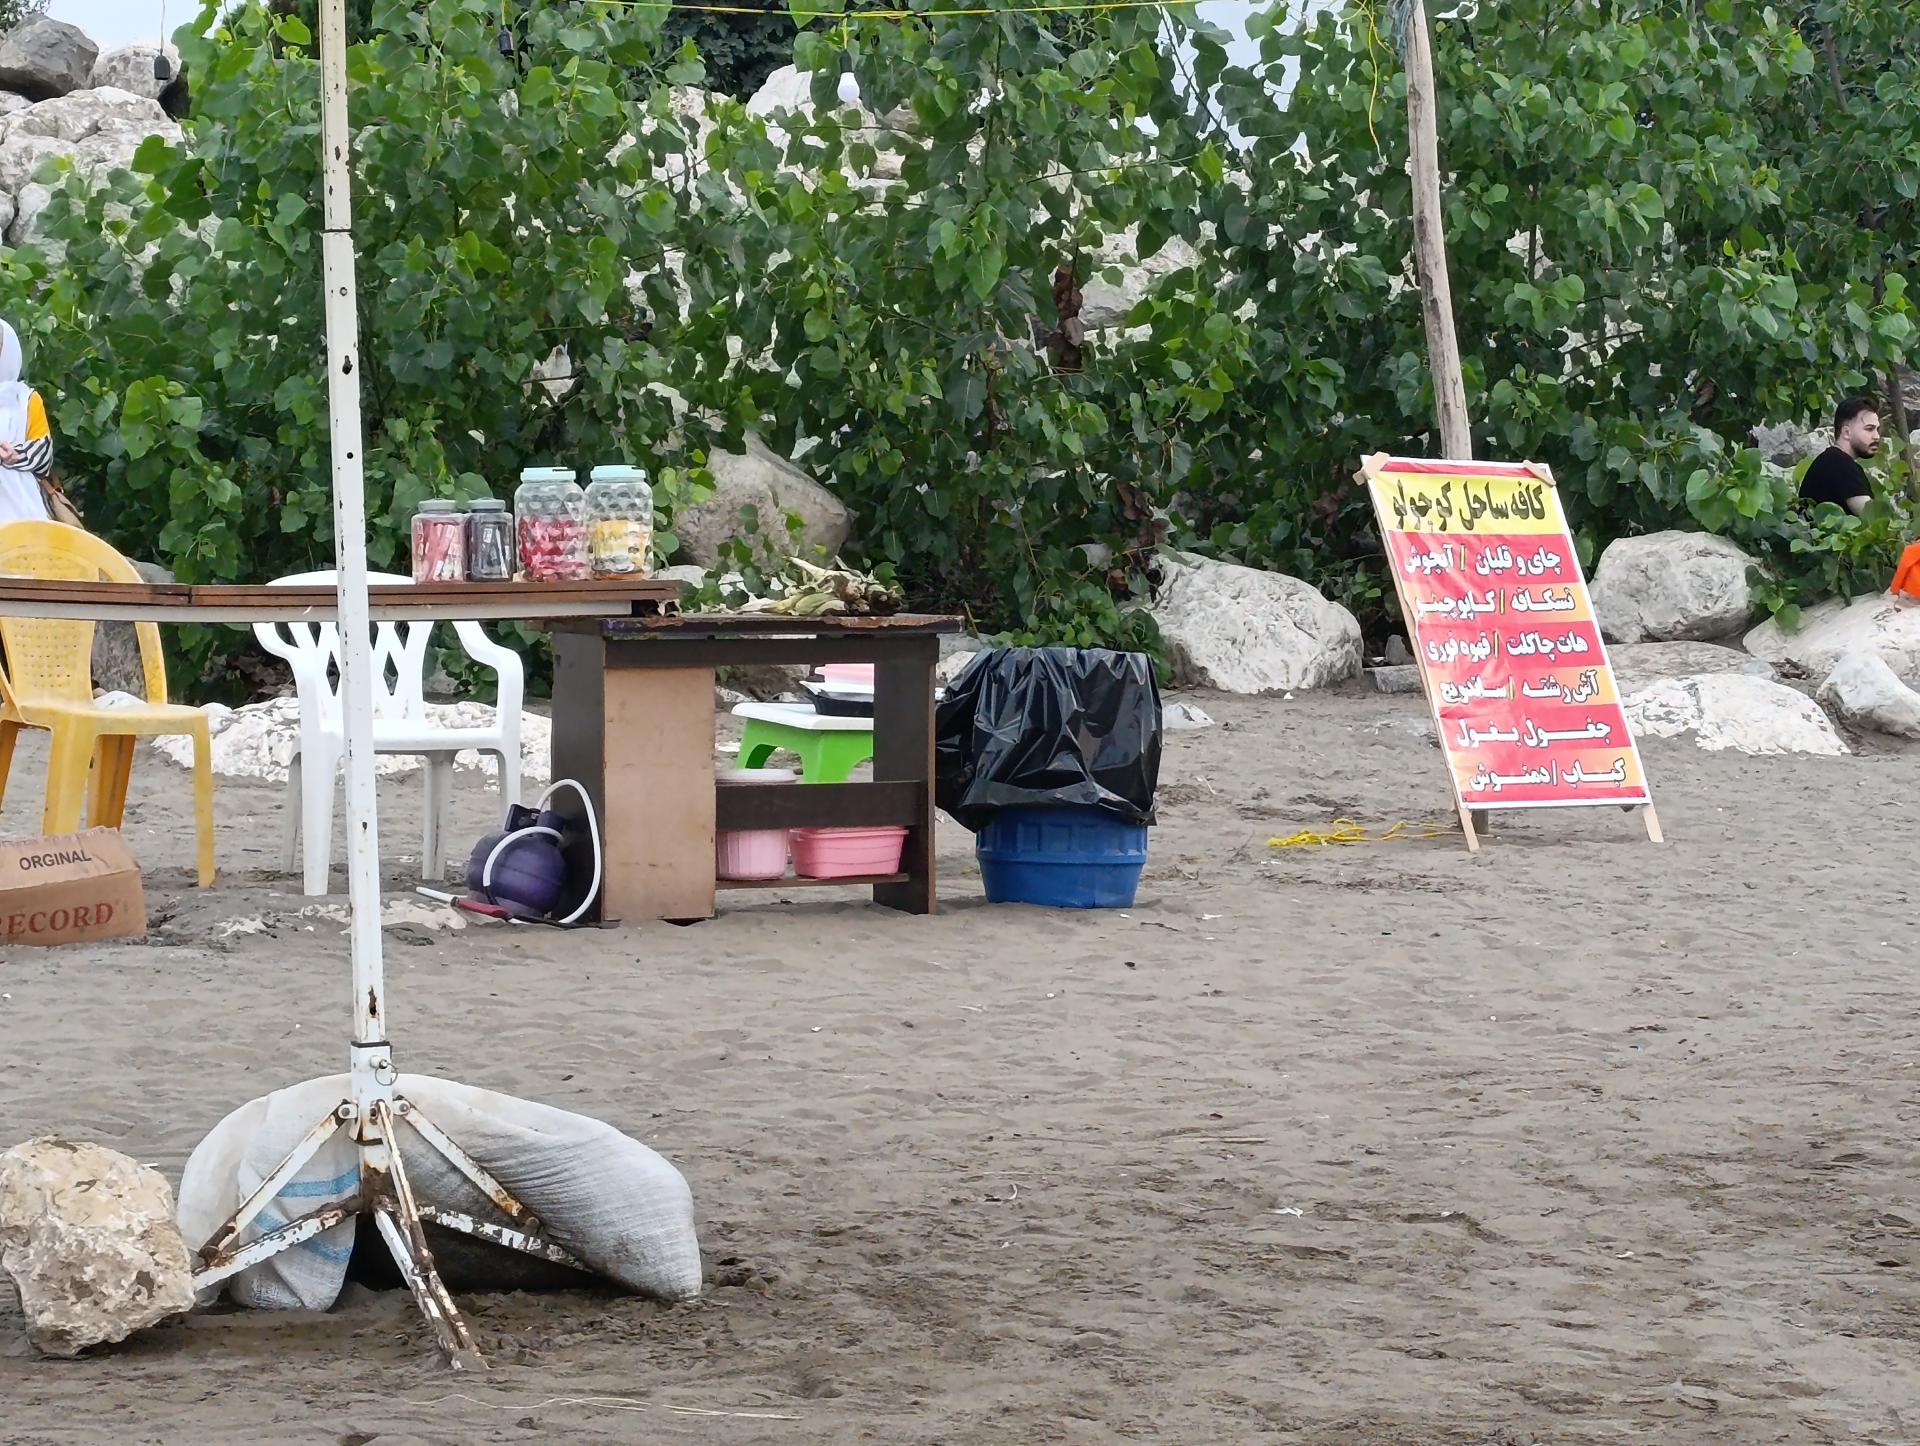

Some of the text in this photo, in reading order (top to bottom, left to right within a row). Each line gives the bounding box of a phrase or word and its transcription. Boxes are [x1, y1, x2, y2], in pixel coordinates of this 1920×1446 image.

[1460, 480, 1509, 530] ساحل
[1511, 481, 1545, 520] کافه
[1405, 544, 1561, 575] چای و قلیان آبجوش
[1510, 587, 1575, 612] نسکافه
[1460, 631, 1491, 660] قهوه
[1507, 631, 1556, 661] چاکلت
[1558, 631, 1589, 654] هات
[1574, 669, 1599, 703] آش
[1457, 716, 1611, 748] جغول بغول
[1469, 758, 1626, 791] کباب دمنوش
[20, 849, 92, 870] ORGINAL
[0, 903, 113, 935] ECORD
